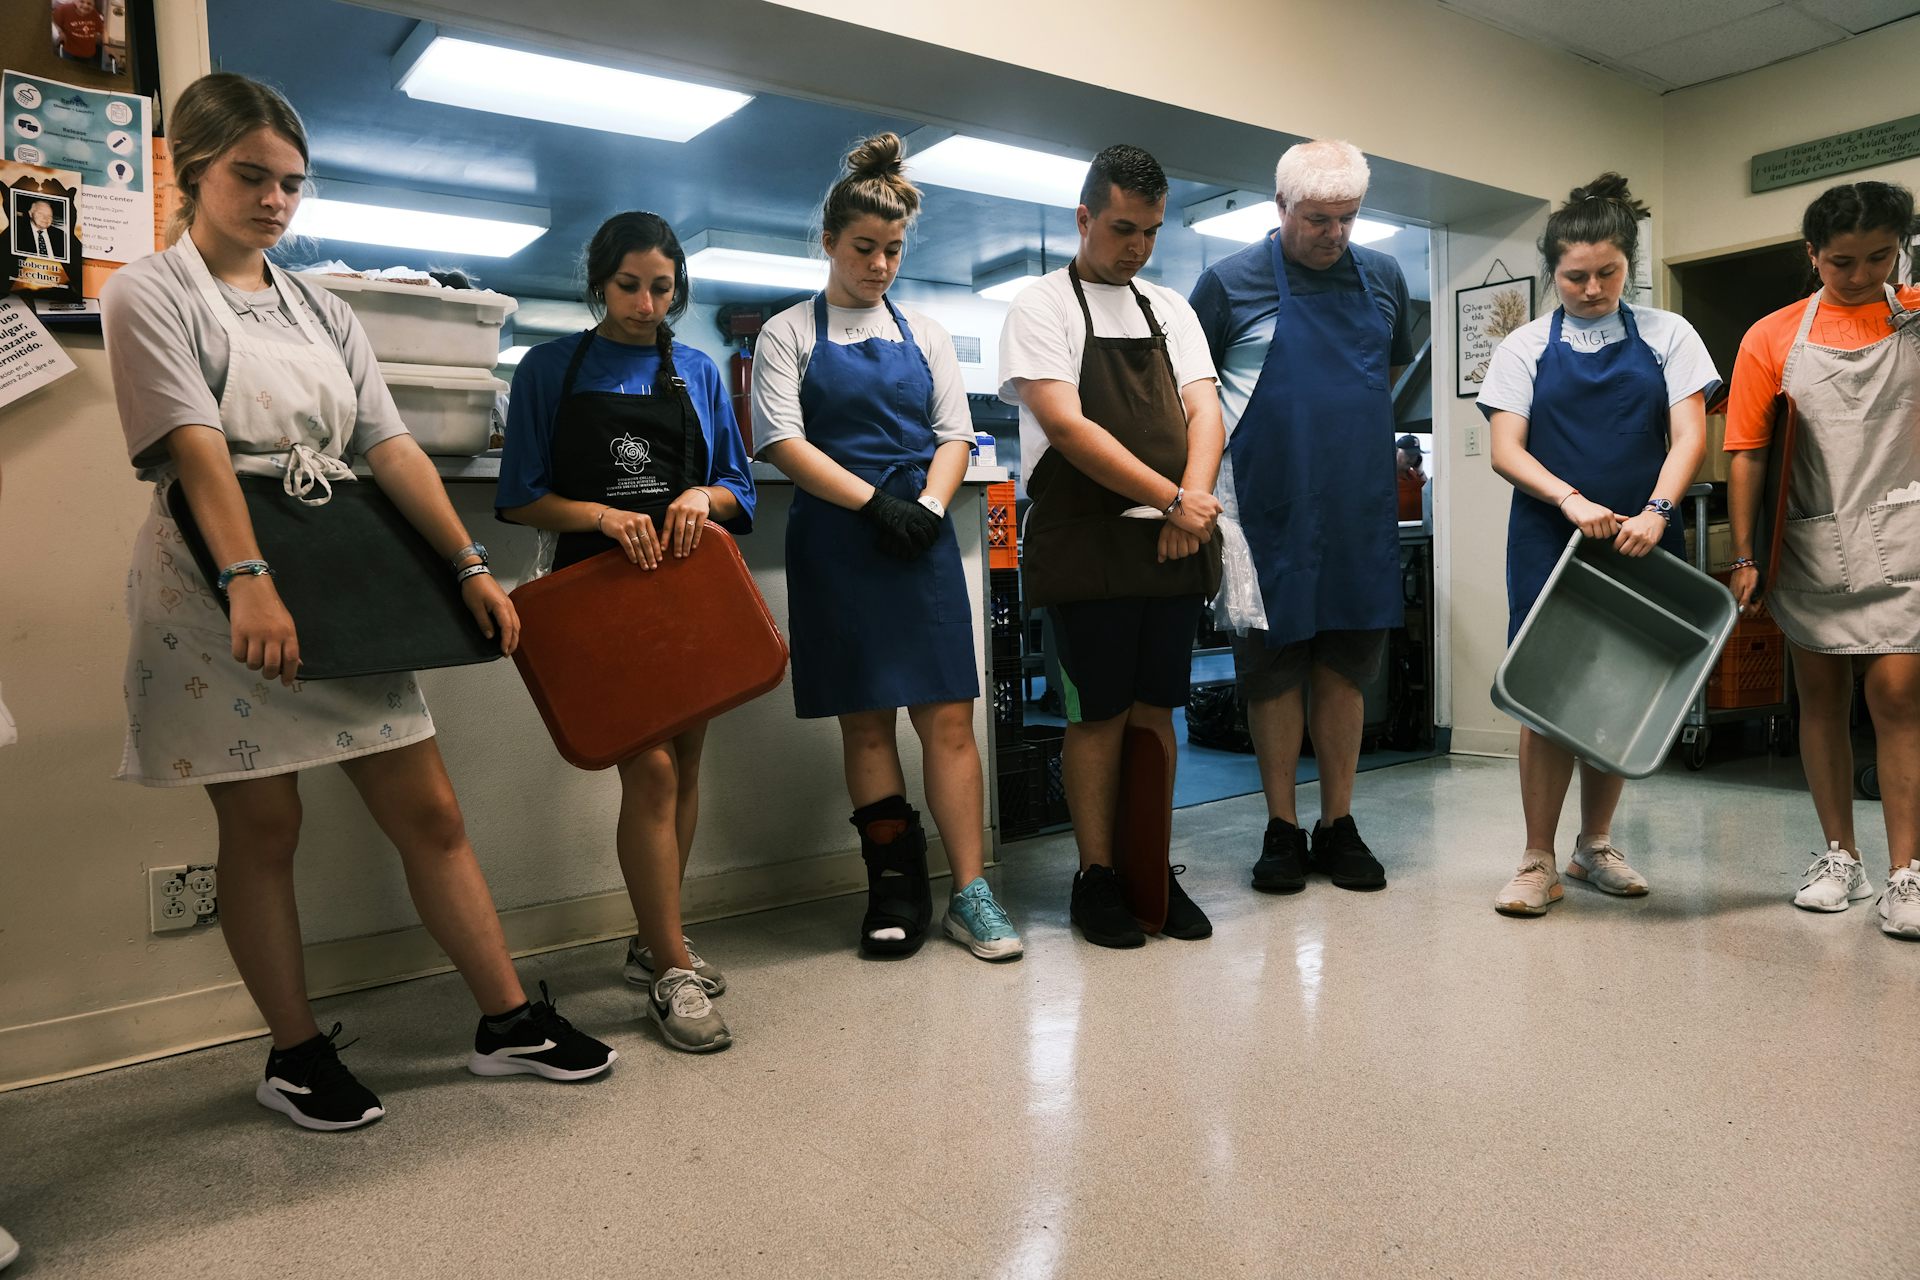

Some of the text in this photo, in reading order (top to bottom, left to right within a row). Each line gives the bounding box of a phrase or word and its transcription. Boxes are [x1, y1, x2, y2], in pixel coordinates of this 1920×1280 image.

[62, 127, 87, 136] Release
[1791, 145, 1817, 156] Want
[1819, 141, 1832, 150] To
[1833, 136, 1854, 148] Ask
[1762, 162, 1788, 174] Want
[1790, 159, 1802, 168] To
[1804, 151, 1822, 163] Ask
[1825, 149, 1843, 158] You
[1845, 145, 1859, 153] To
[1861, 135, 1889, 149] Walk
[62, 156, 89, 166] Connect
[1768, 169, 1787, 184] And
[1789, 166, 1811, 177] Take
[1812, 161, 1834, 172] Care
[1836, 155, 1851, 168] Of
[1851, 153, 1871, 163] One
[109, 195, 134, 203] Center
[18, 259, 49, 271] Robert
[18, 269, 61, 282] Lechner
[1463, 303, 1483, 313] Give
[1, 312, 19, 325] uso
[1471, 312, 1485, 321] this
[1463, 323, 1478, 332] day
[1820, 316, 1881, 343] ERIN
[1466, 332, 1483, 342] Our
[1472, 339, 1493, 350] daily
[1464, 350, 1492, 360] Bread
[16, 370, 33, 380] Zona
